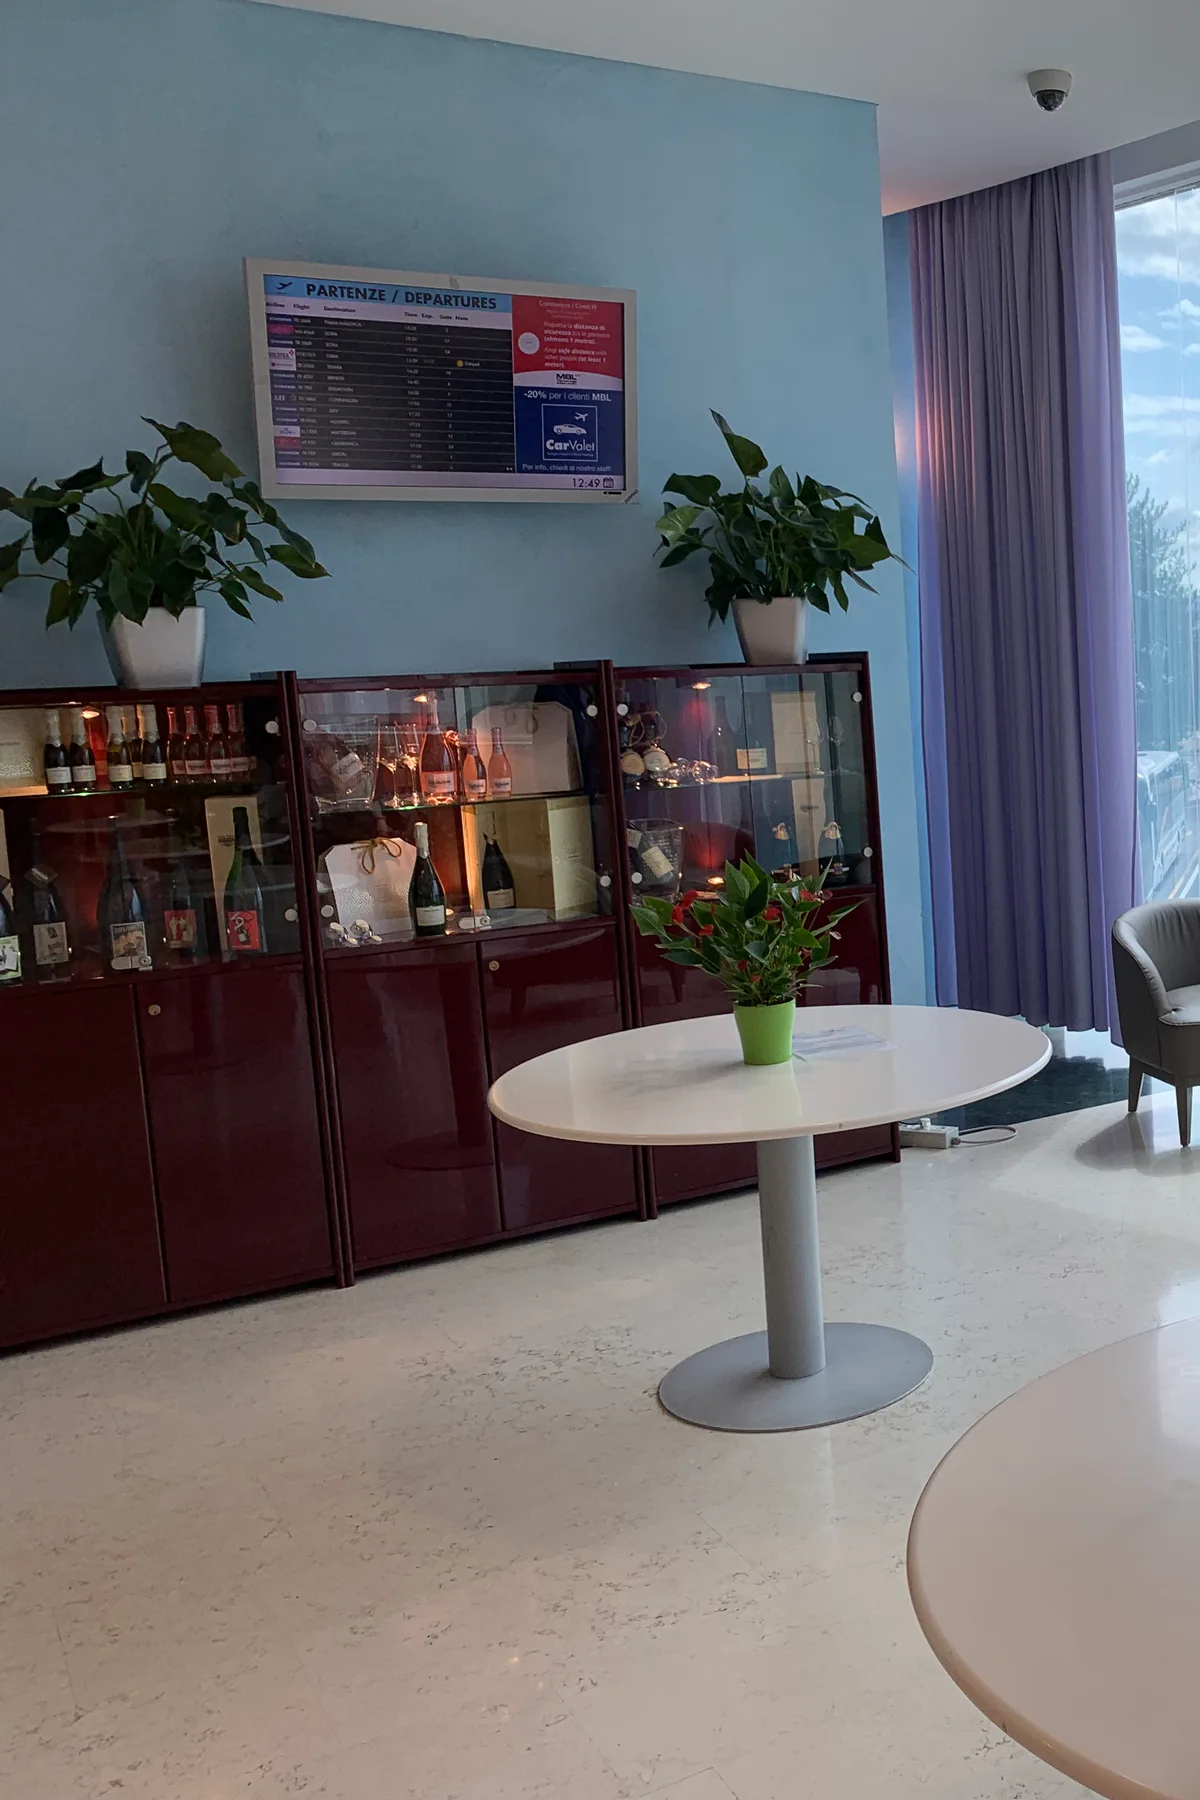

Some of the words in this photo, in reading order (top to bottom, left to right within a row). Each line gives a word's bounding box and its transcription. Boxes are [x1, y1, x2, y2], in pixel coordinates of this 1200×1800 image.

[306, 283, 386, 301] PARTENZE
[391, 289, 398, 303] /
[404, 291, 497, 310] DEPARTURES
[539, 300, 570, 309] Coronavirus
[573, 322, 598, 331] distanza
[544, 328, 571, 336] sicurezza
[571, 347, 595, 355] distance
[524, 390, 547, 399] -20%
[549, 393, 563, 401] per
[568, 392, 590, 401] clienti
[592, 392, 611, 402] MBL
[546, 439, 595, 452] CarValet
[573, 477, 600, 488] 12:49
